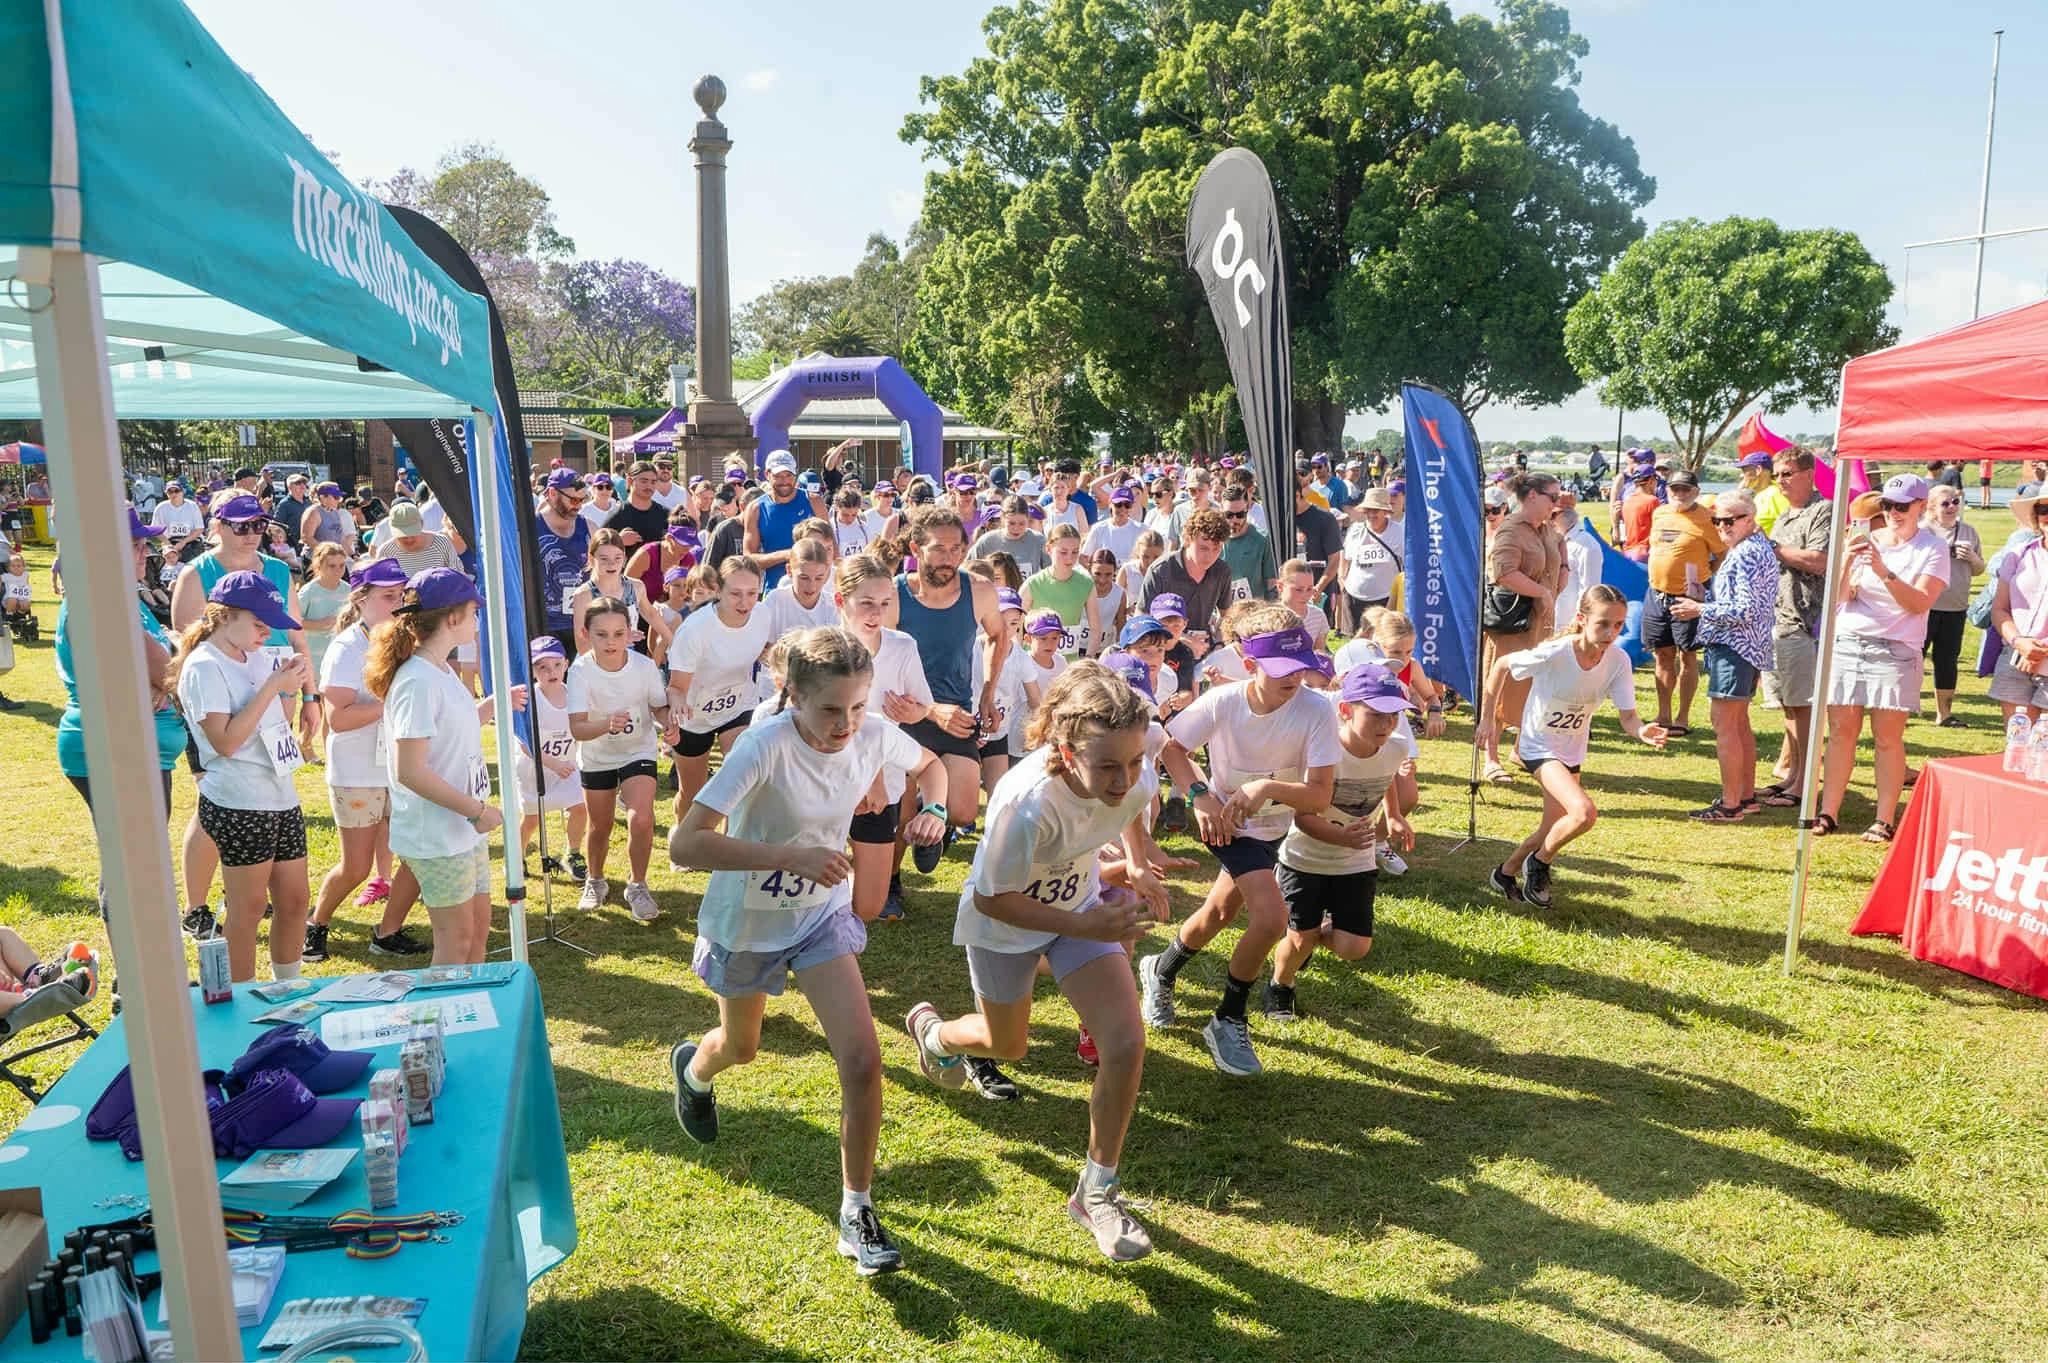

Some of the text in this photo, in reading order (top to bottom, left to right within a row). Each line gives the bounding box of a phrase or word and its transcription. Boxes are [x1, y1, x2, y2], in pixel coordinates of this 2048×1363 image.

[807, 370, 860, 384] FINISH
[430, 416, 464, 475] Engineering
[1363, 550, 1385, 561] 503
[1421, 455, 1445, 666] The Athlete's Foot
[702, 694, 737, 713] 439
[1547, 711, 1585, 730] 226
[277, 735, 298, 764] 448
[542, 738, 573, 757] 457
[1922, 830, 2048, 914] jett
[1022, 873, 1080, 905] 438
[1950, 890, 2048, 936] 24 hour fitn
